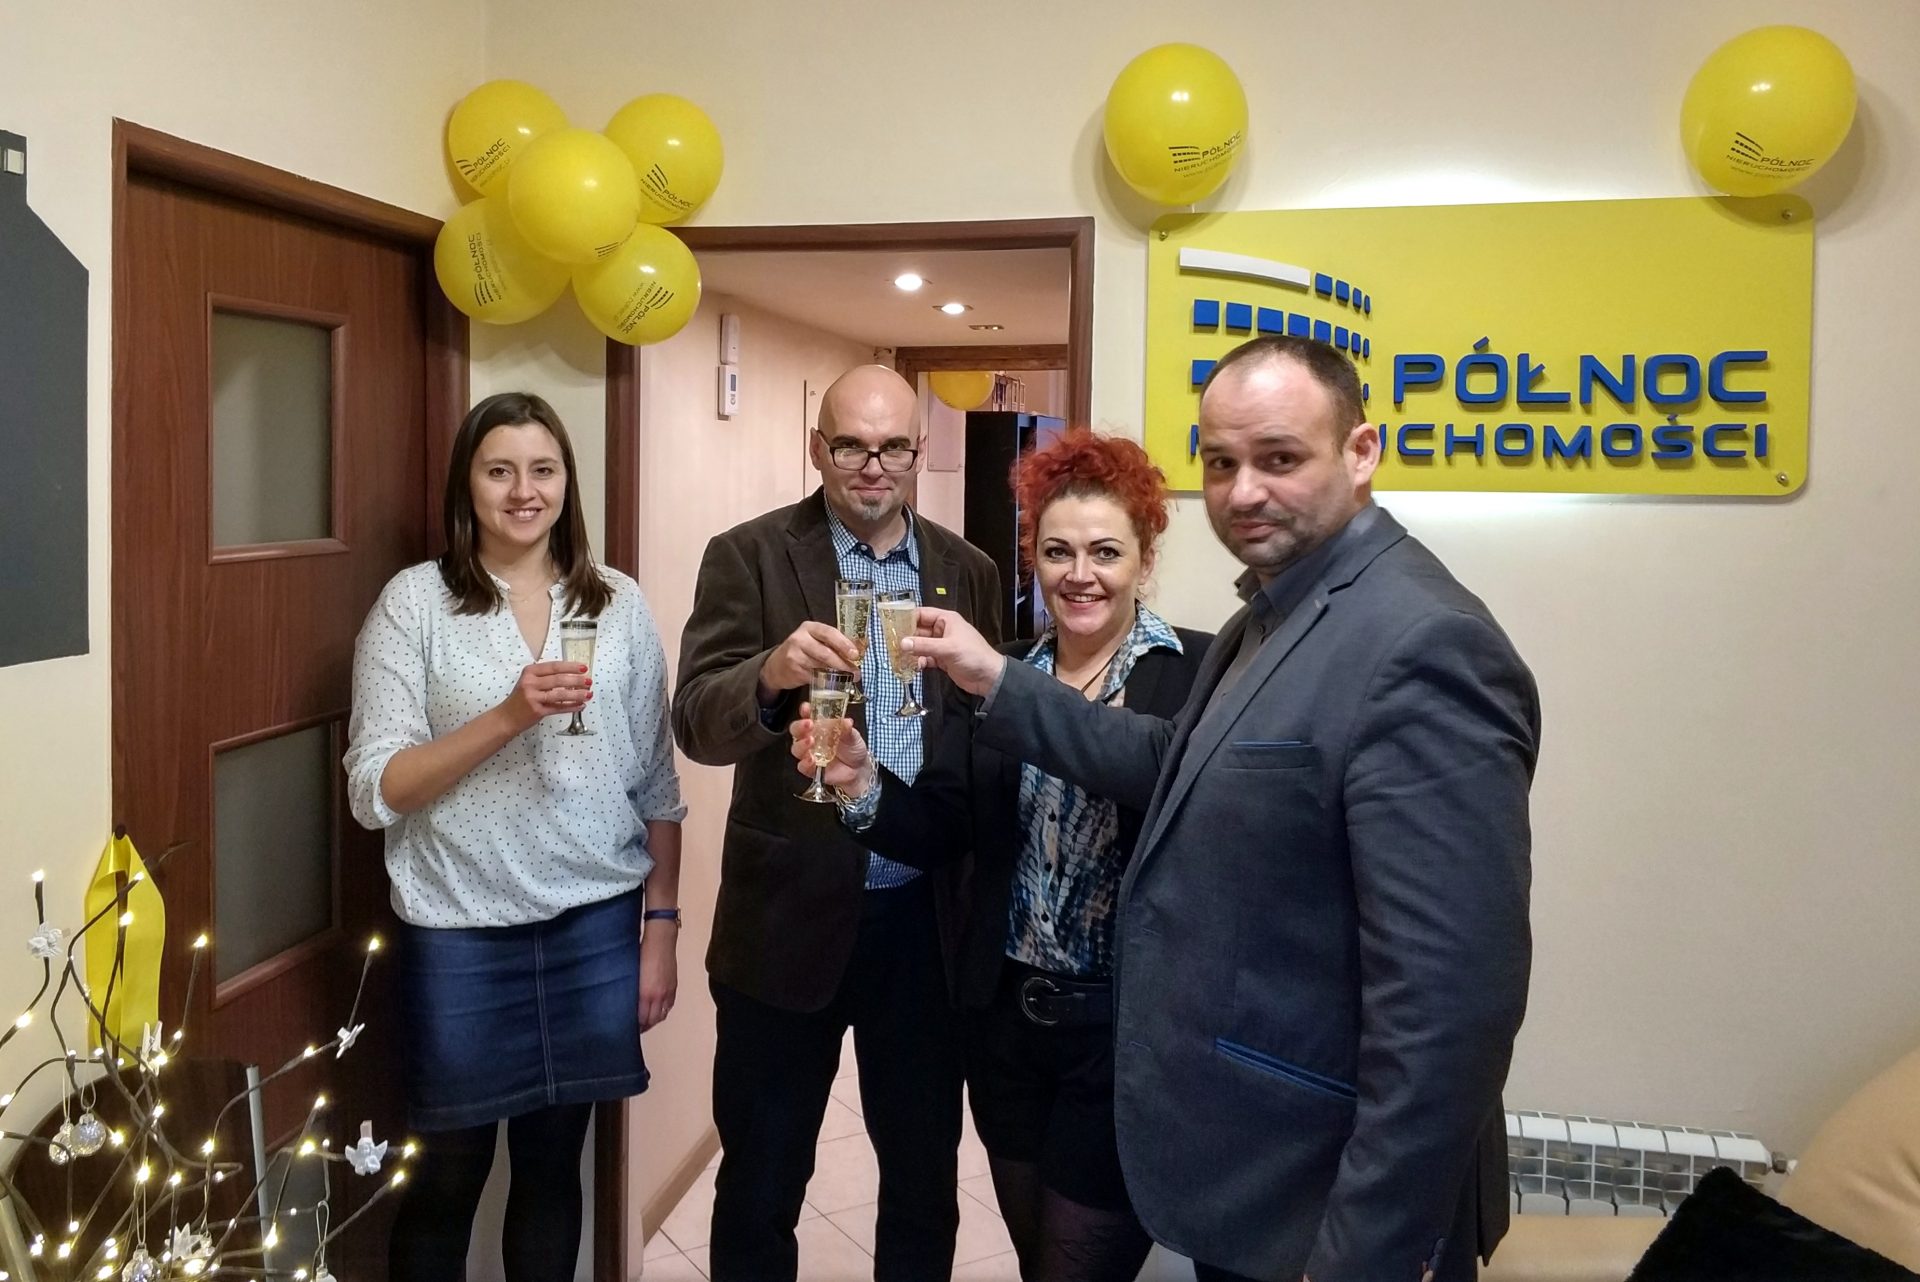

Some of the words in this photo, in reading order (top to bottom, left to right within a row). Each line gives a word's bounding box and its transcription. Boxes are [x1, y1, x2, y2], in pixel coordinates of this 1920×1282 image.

[1201, 129, 1241, 159] PÓŁNOC
[1759, 156, 1815, 166] PÓŁNOC
[466, 233, 485, 281] PÓŁNOC
[621, 304, 650, 335] PÓŁNOC
[1393, 336, 1768, 406] PÓŁNOC
[1190, 414, 1768, 459] CHOMOŚCI
